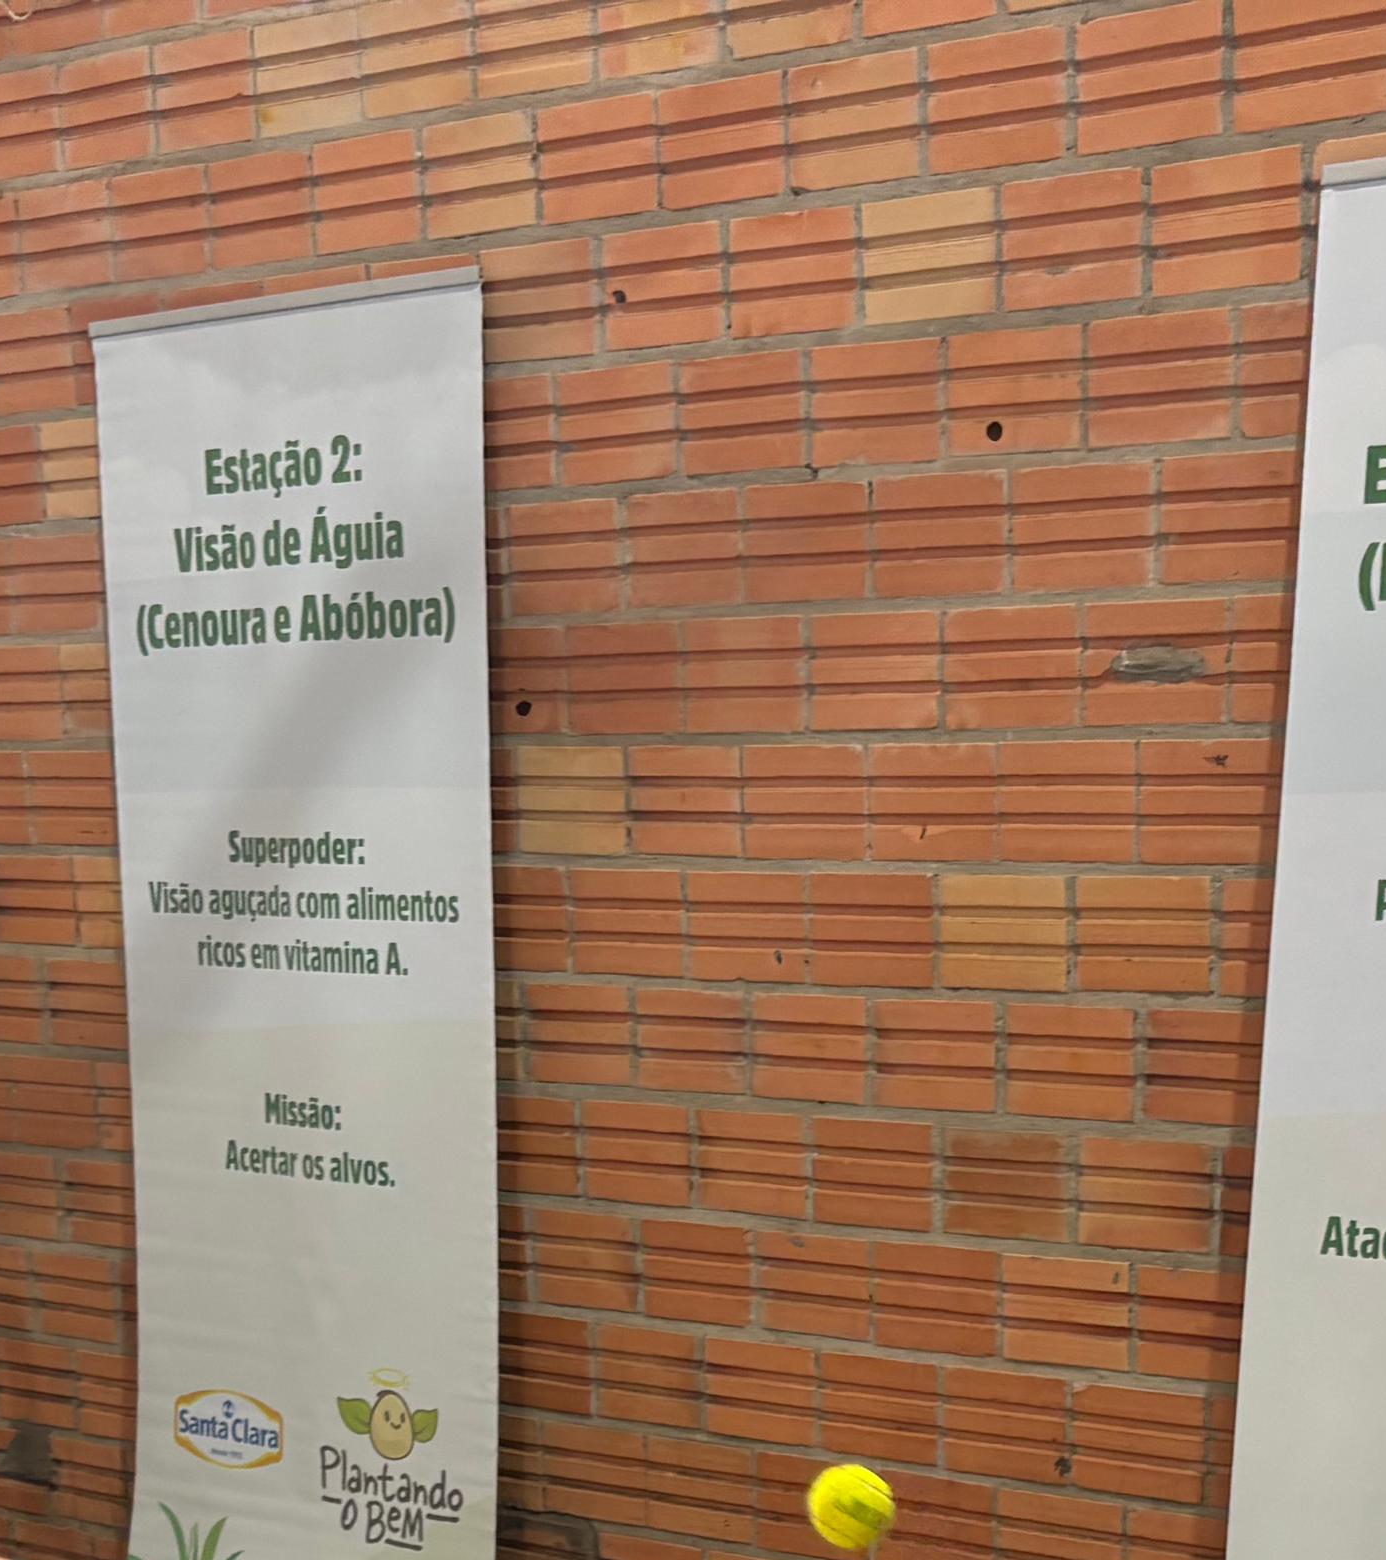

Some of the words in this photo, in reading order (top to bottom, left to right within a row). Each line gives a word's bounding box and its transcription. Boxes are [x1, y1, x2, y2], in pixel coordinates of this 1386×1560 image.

[204, 440, 323, 498] Estação
[331, 434, 363, 484] 2:
[174, 524, 256, 573] Visão
[264, 519, 301, 566] de
[310, 506, 404, 569] Águia
[136, 603, 267, 656] (Cenoura
[274, 604, 291, 643] e
[300, 586, 456, 644] Abóbora)
[228, 830, 365, 868] Superpoder:
[149, 881, 203, 915] Visão
[209, 884, 291, 923] aguçada
[297, 890, 340, 919] com
[347, 887, 459, 923] alimentos
[198, 935, 245, 969] ricos
[252, 944, 280, 971] em
[285, 938, 379, 976] vitamina
[385, 942, 409, 976] A.
[264, 1093, 342, 1131] Missão:
[225, 1140, 297, 1178] Acertar
[302, 1155, 324, 1182] os
[330, 1153, 396, 1188] alvos.
[179, 1408, 229, 1440] Santa
[232, 1418, 279, 1449] Clara
[320, 1445, 464, 1512] Plantando
